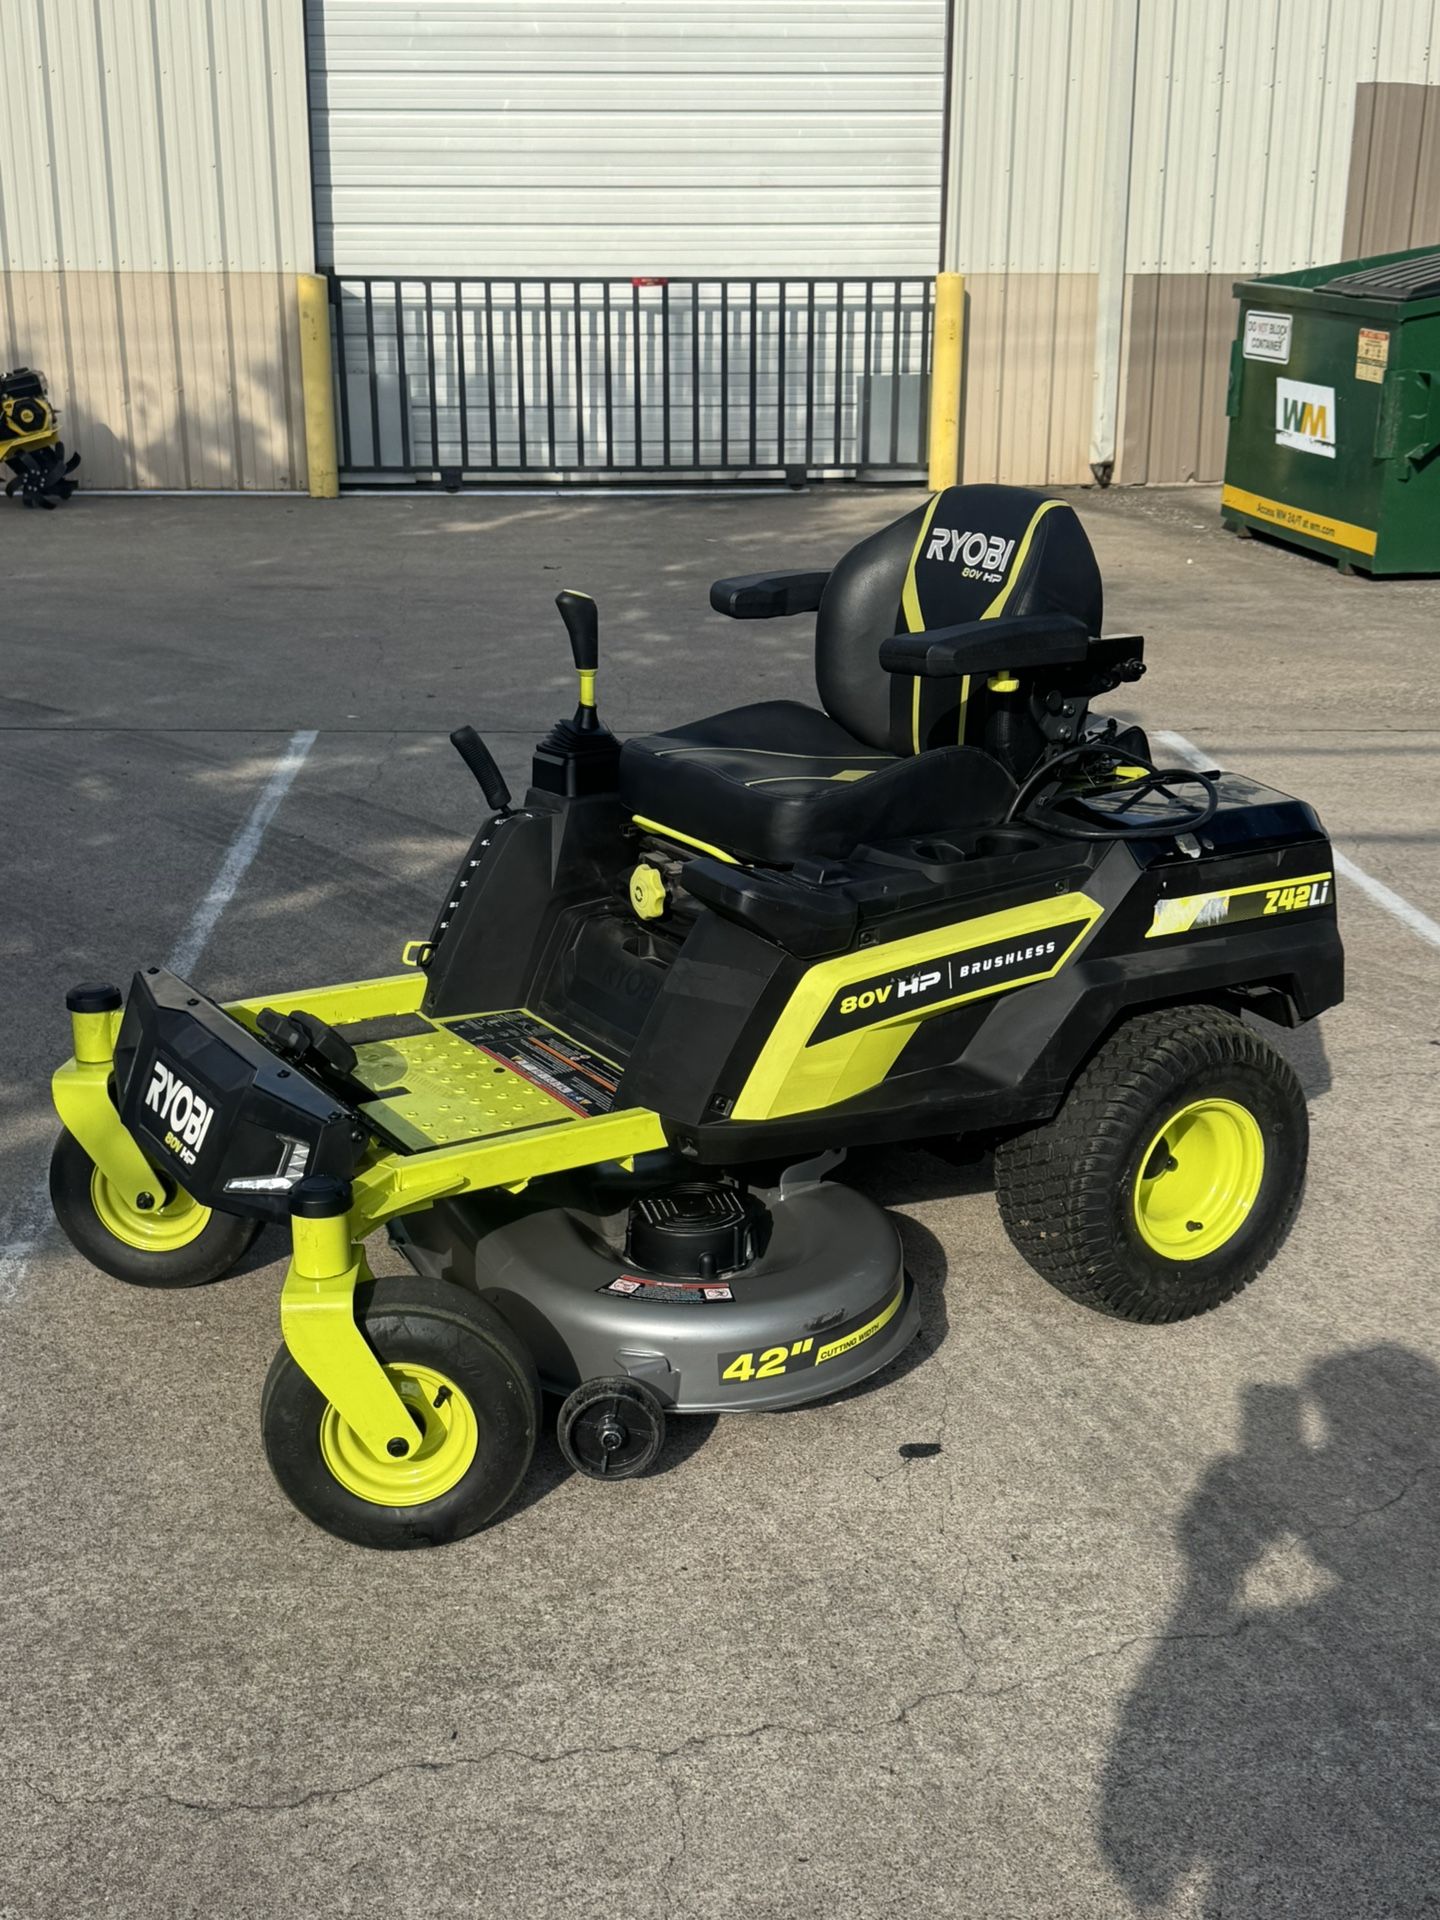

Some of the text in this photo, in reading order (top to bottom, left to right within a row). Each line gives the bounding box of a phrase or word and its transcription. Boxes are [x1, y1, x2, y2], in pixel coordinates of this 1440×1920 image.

[1283, 397, 1326, 438] WM
[926, 528, 1015, 572] RYOBI
[962, 567, 1003, 583] 80V HP
[1263, 881, 1330, 914] Z42Li
[840, 942, 1055, 1014] 80V HP BRUSHLESS
[145, 1061, 214, 1153] RYOBI
[164, 1131, 197, 1165] 80V HP
[722, 1323, 881, 1382] 42" CUTTING WIDTH
